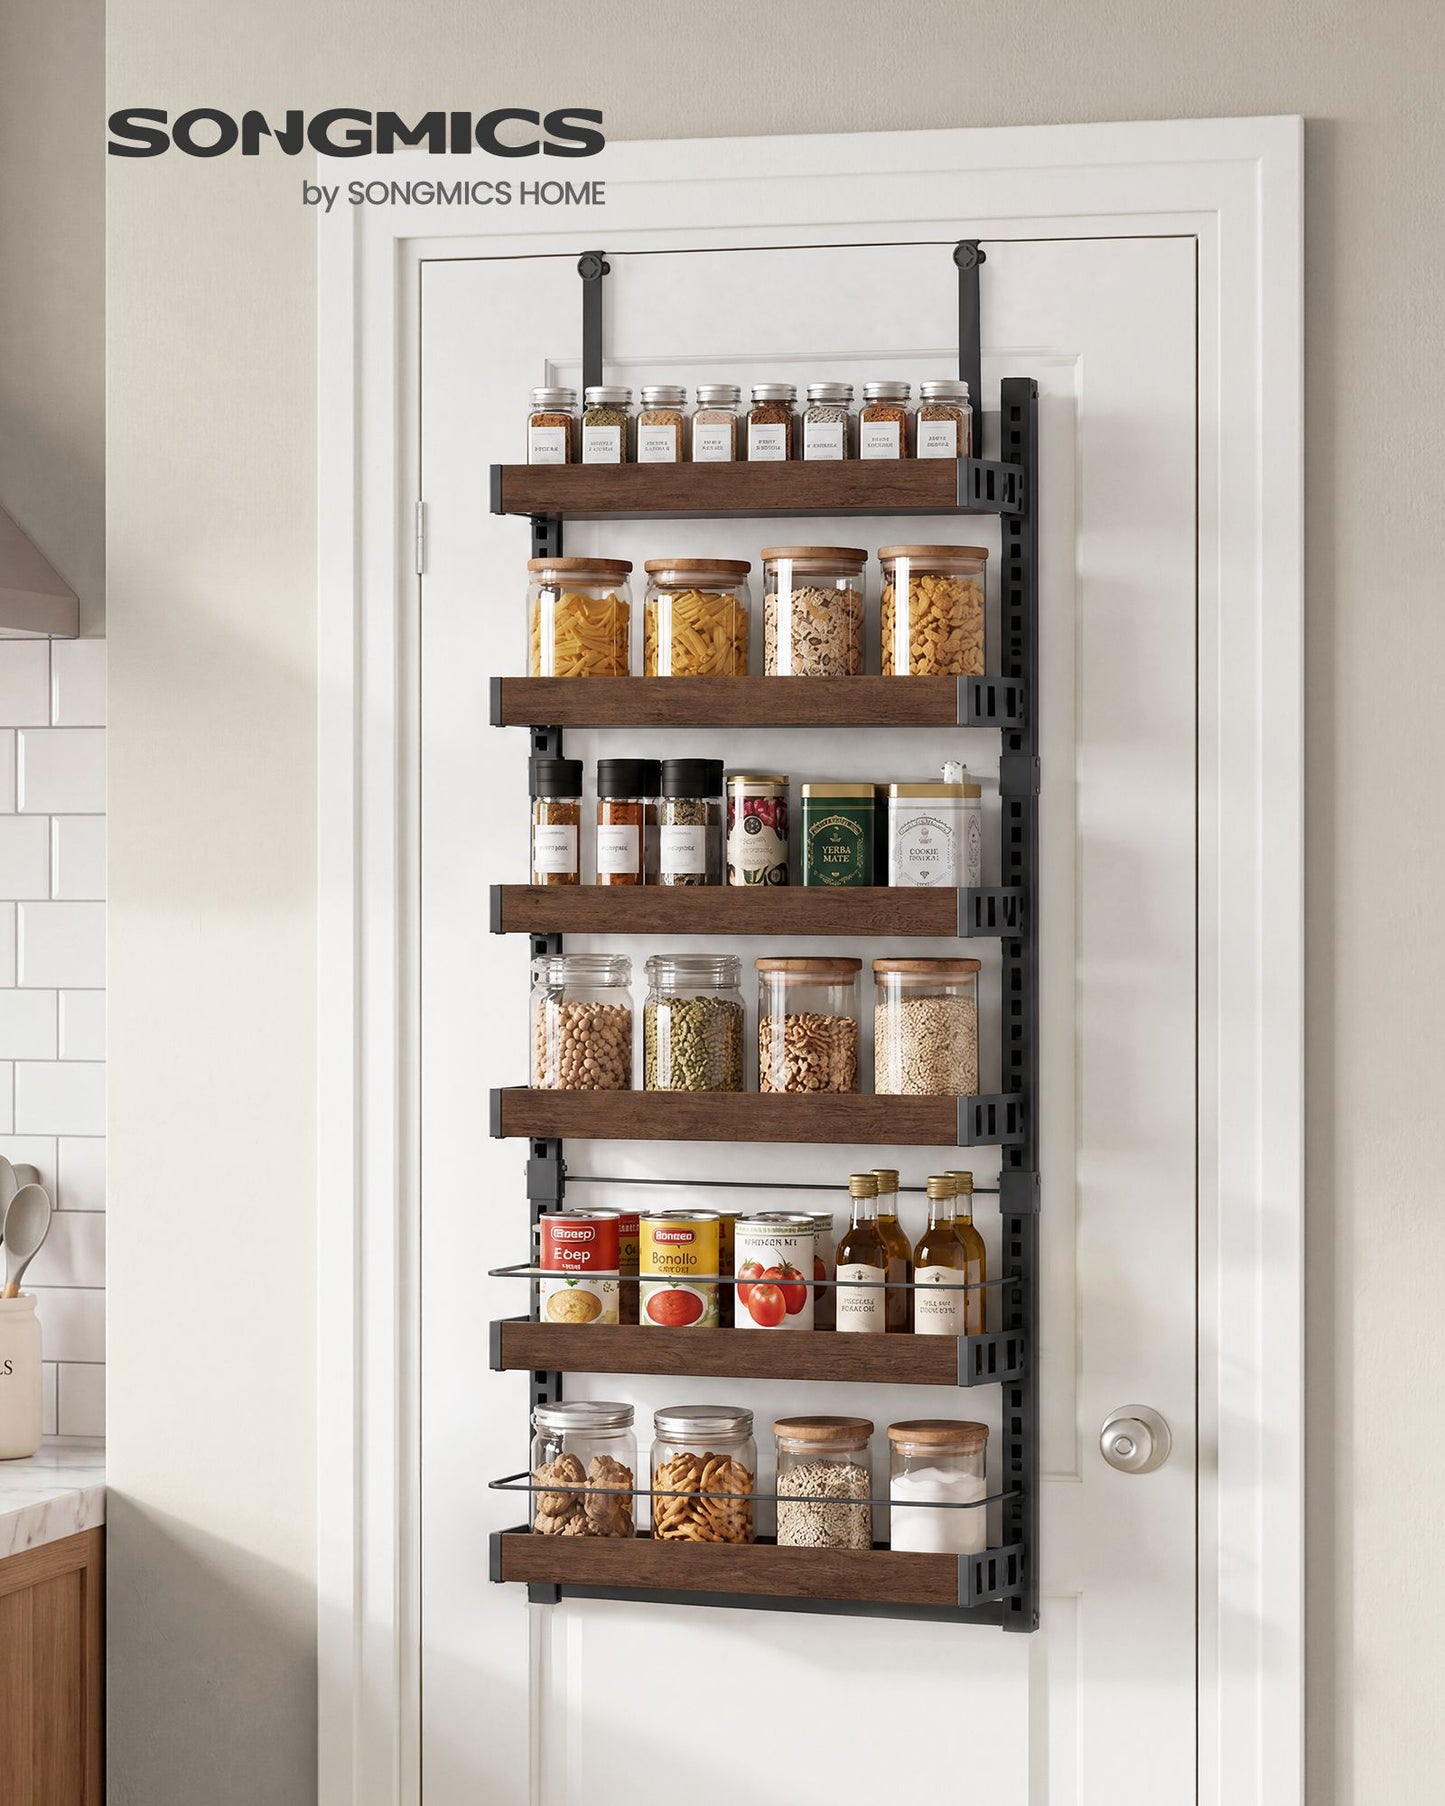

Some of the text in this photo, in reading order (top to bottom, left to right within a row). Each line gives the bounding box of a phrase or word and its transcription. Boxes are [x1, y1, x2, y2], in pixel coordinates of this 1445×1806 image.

[822, 846, 851, 854] YERBA
[823, 855, 850, 863] MATE
[652, 1251, 697, 1265] Bonollo
